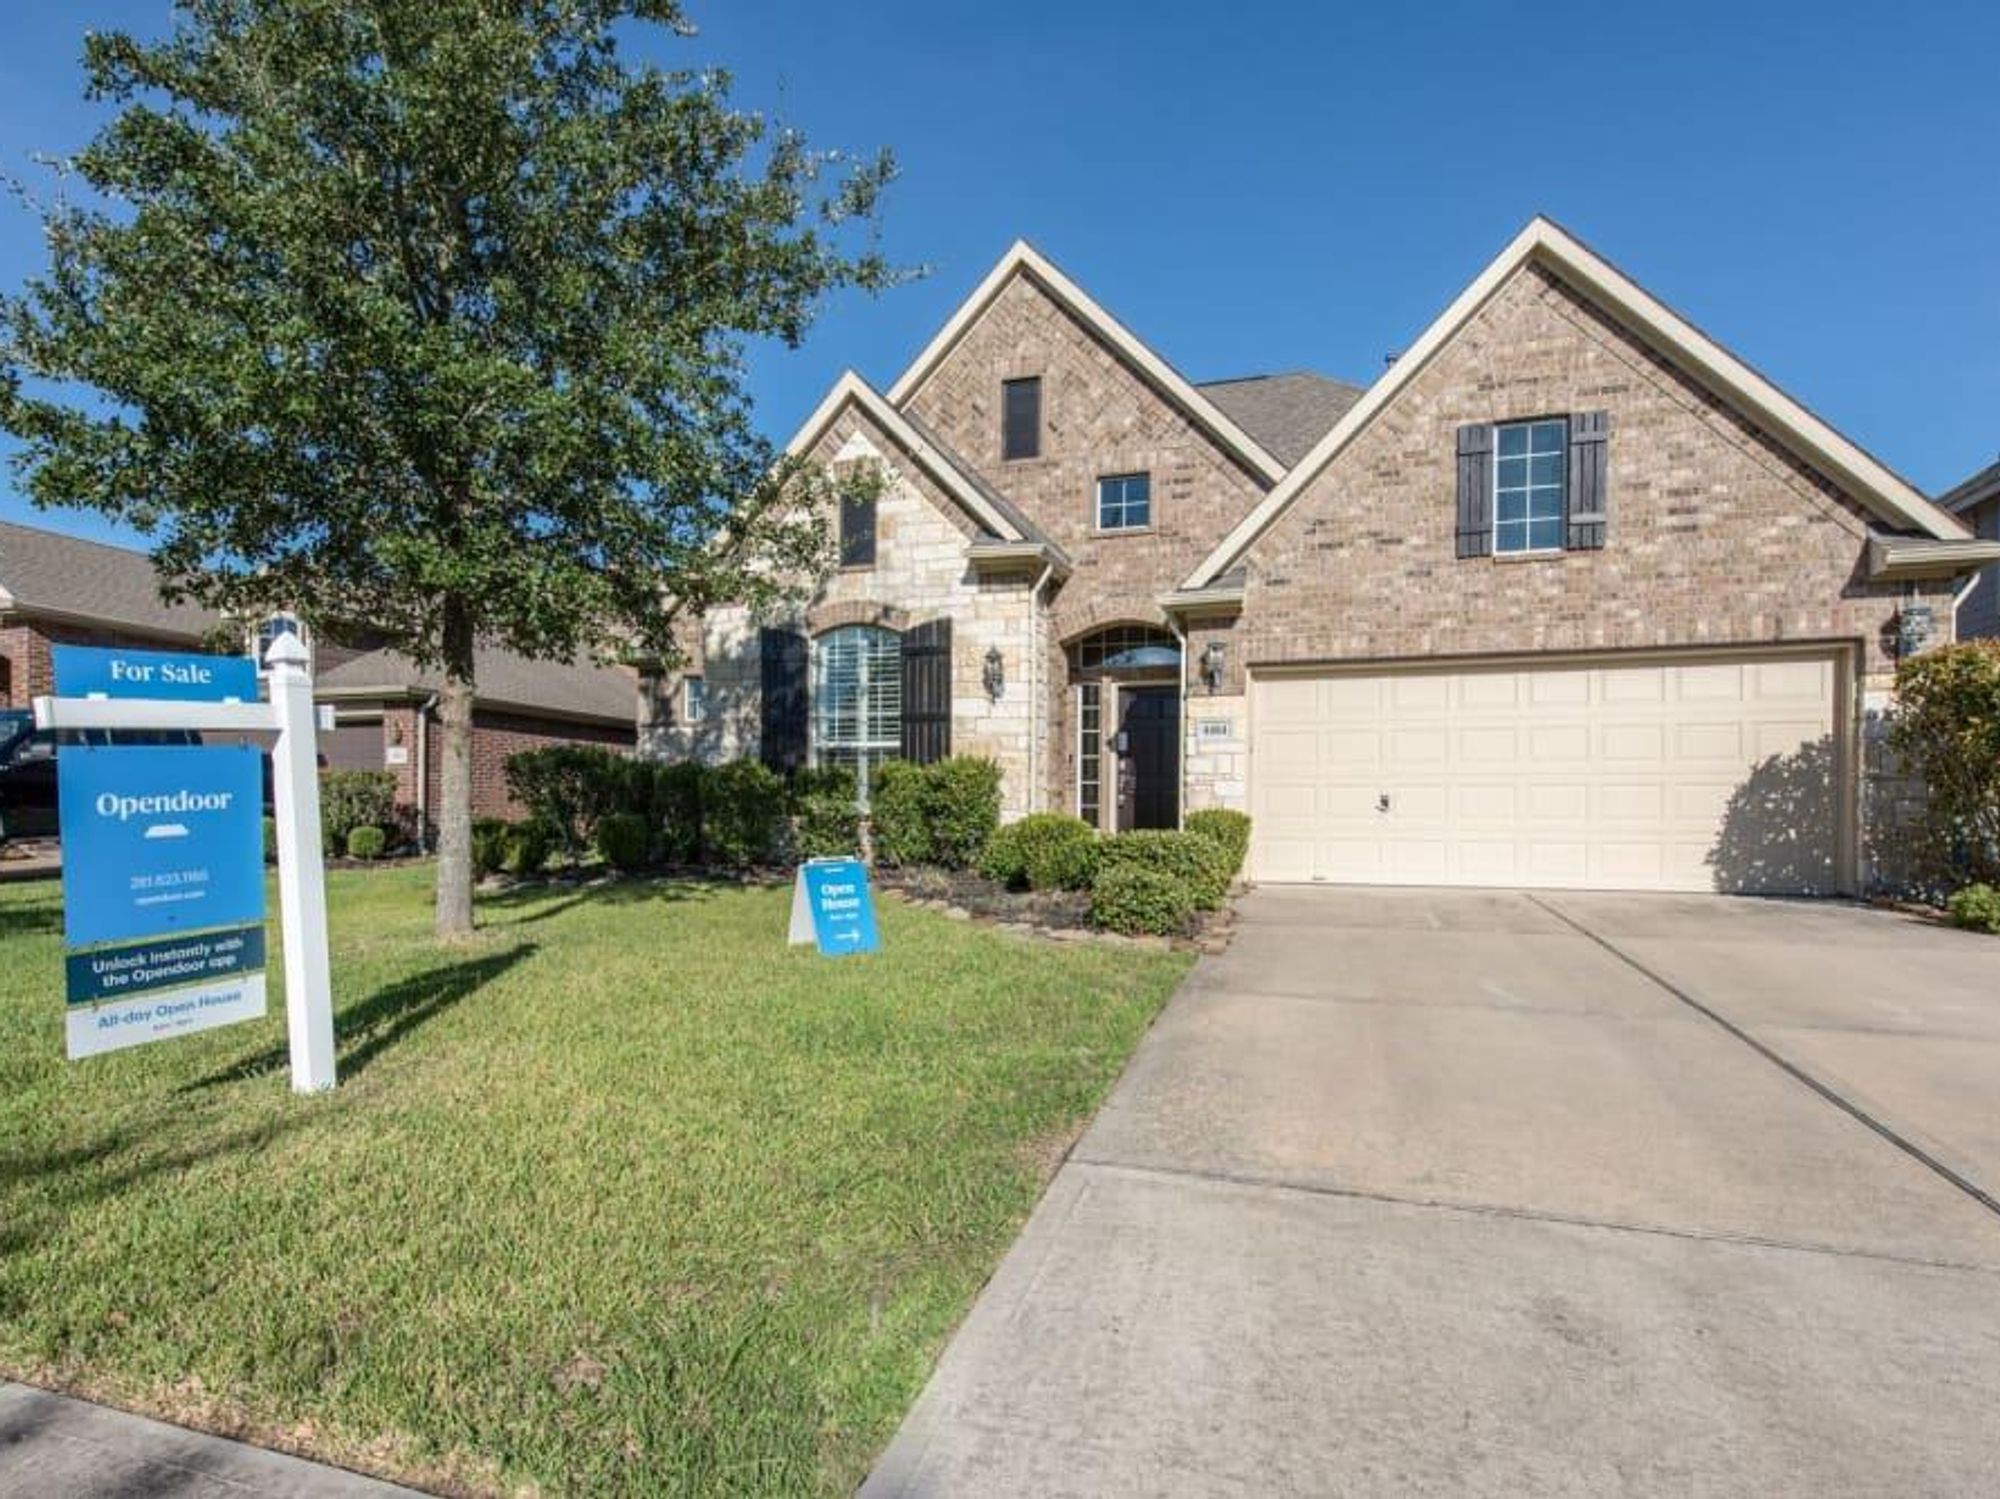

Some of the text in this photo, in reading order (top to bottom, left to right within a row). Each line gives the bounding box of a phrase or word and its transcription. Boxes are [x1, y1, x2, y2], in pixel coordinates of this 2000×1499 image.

[110, 660, 212, 684] For Sale
[96, 790, 232, 820] Opendoor
[821, 884, 855, 899] Open
[92, 953, 146, 974] Unlock
[150, 943, 211, 964] Instantly
[102, 955, 237, 988] the Opendoor app
[98, 1010, 151, 1028] All-day
[155, 1000, 196, 1017] Open
[199, 990, 242, 1008] House
